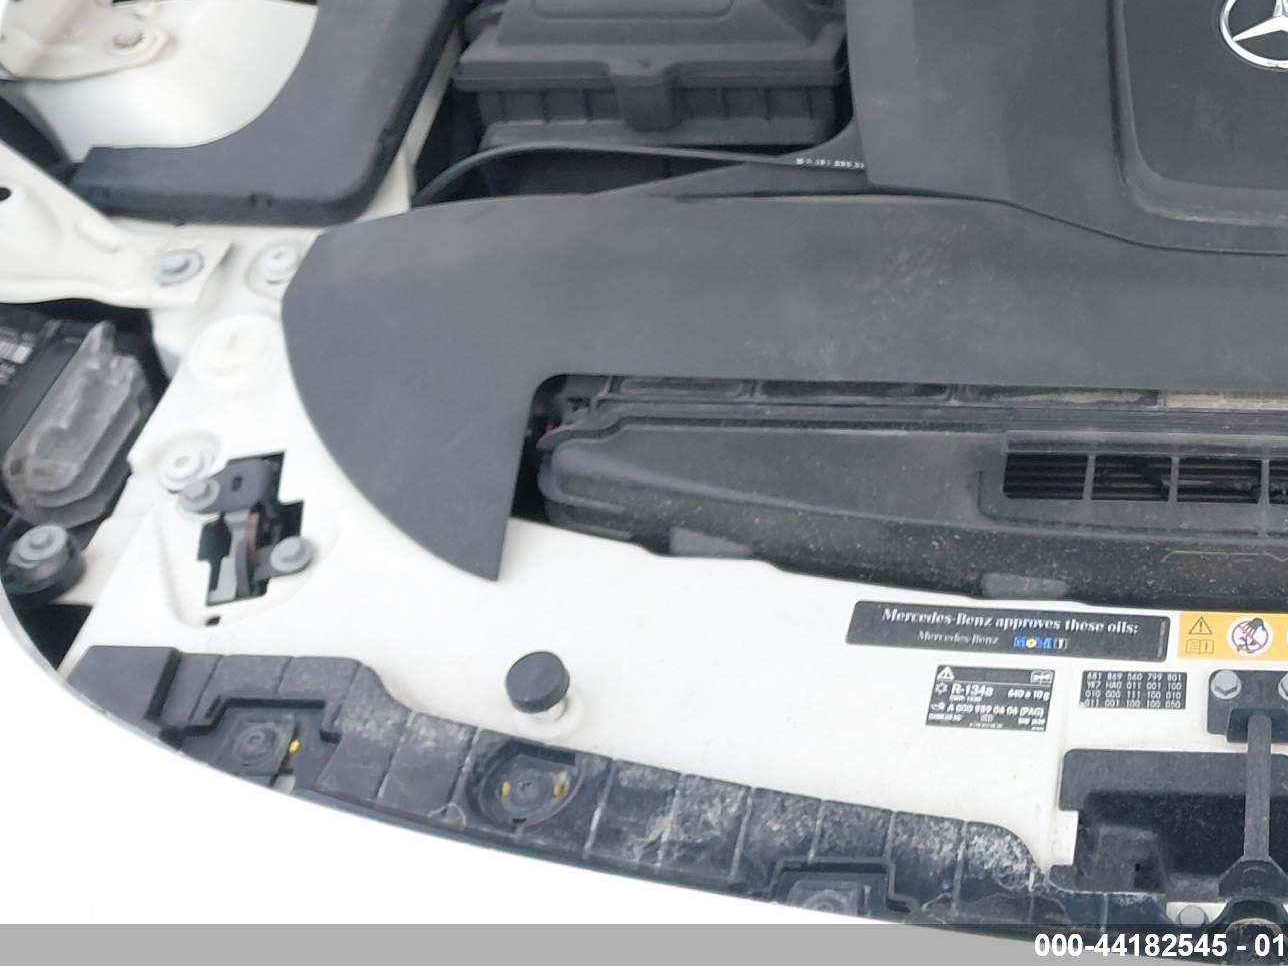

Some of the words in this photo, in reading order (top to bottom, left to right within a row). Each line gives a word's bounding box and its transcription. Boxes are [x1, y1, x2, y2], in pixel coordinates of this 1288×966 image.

[882, 608, 992, 627] Mercedes-Benz
[995, 617, 1061, 631] approves
[1065, 618, 1104, 632] these
[1107, 621, 1139, 635] oils:
[951, 683, 994, 697] R-134a
[1126, 682, 1141, 690] 011
[1146, 682, 1161, 691] 001
[1167, 683, 1182, 691] 100
[1085, 690, 1101, 698] 010
[1127, 690, 1141, 699] 111
[1147, 691, 1161, 699] 100
[1165, 691, 1181, 700] 010
[946, 703, 954, 713] A
[1126, 699, 1141, 707] 100
